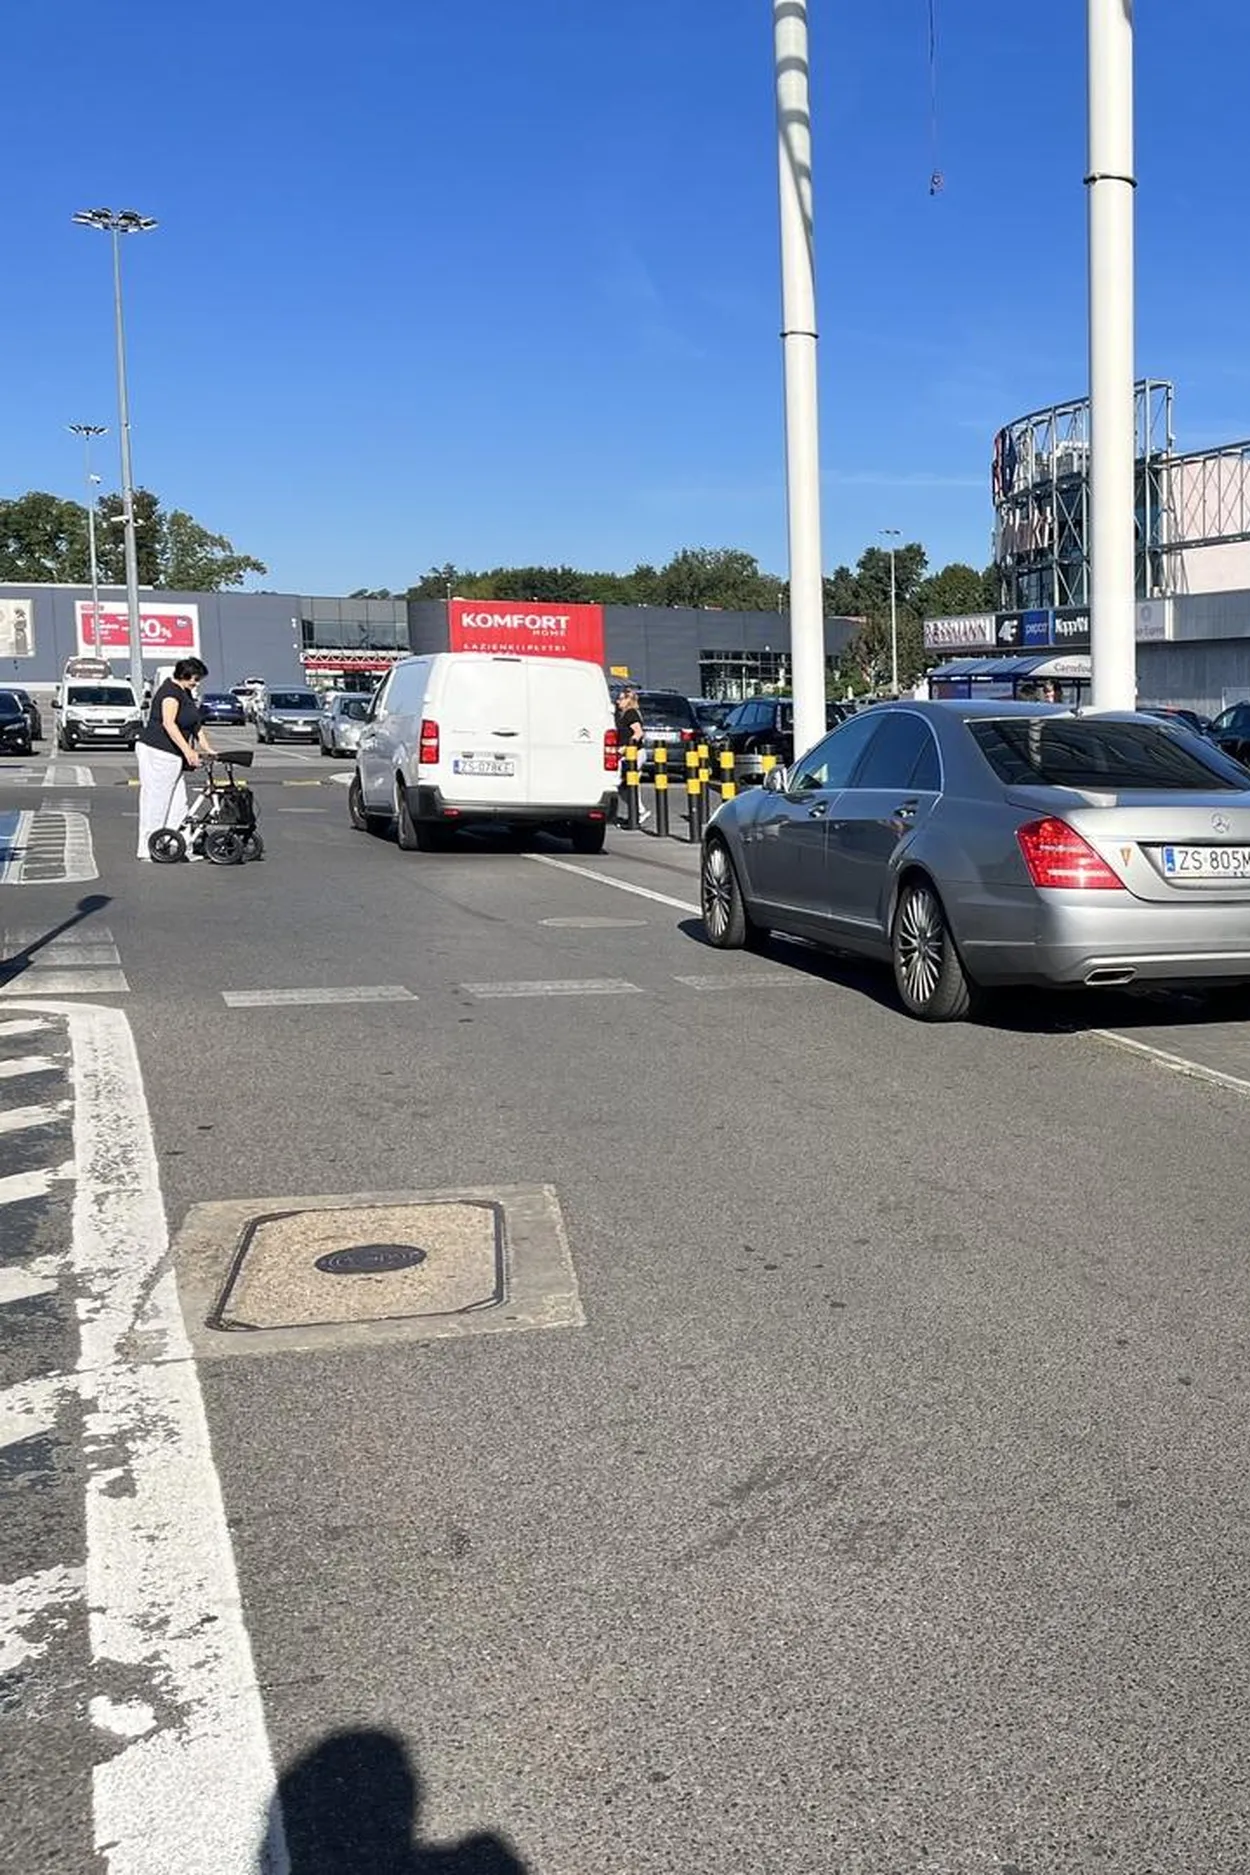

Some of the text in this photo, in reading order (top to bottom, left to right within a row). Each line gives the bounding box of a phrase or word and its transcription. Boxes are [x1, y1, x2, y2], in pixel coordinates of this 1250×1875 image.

[461, 612, 570, 630] KOMFORT
[532, 629, 566, 637] HOME
[1178, 850, 1202, 871] ZS
